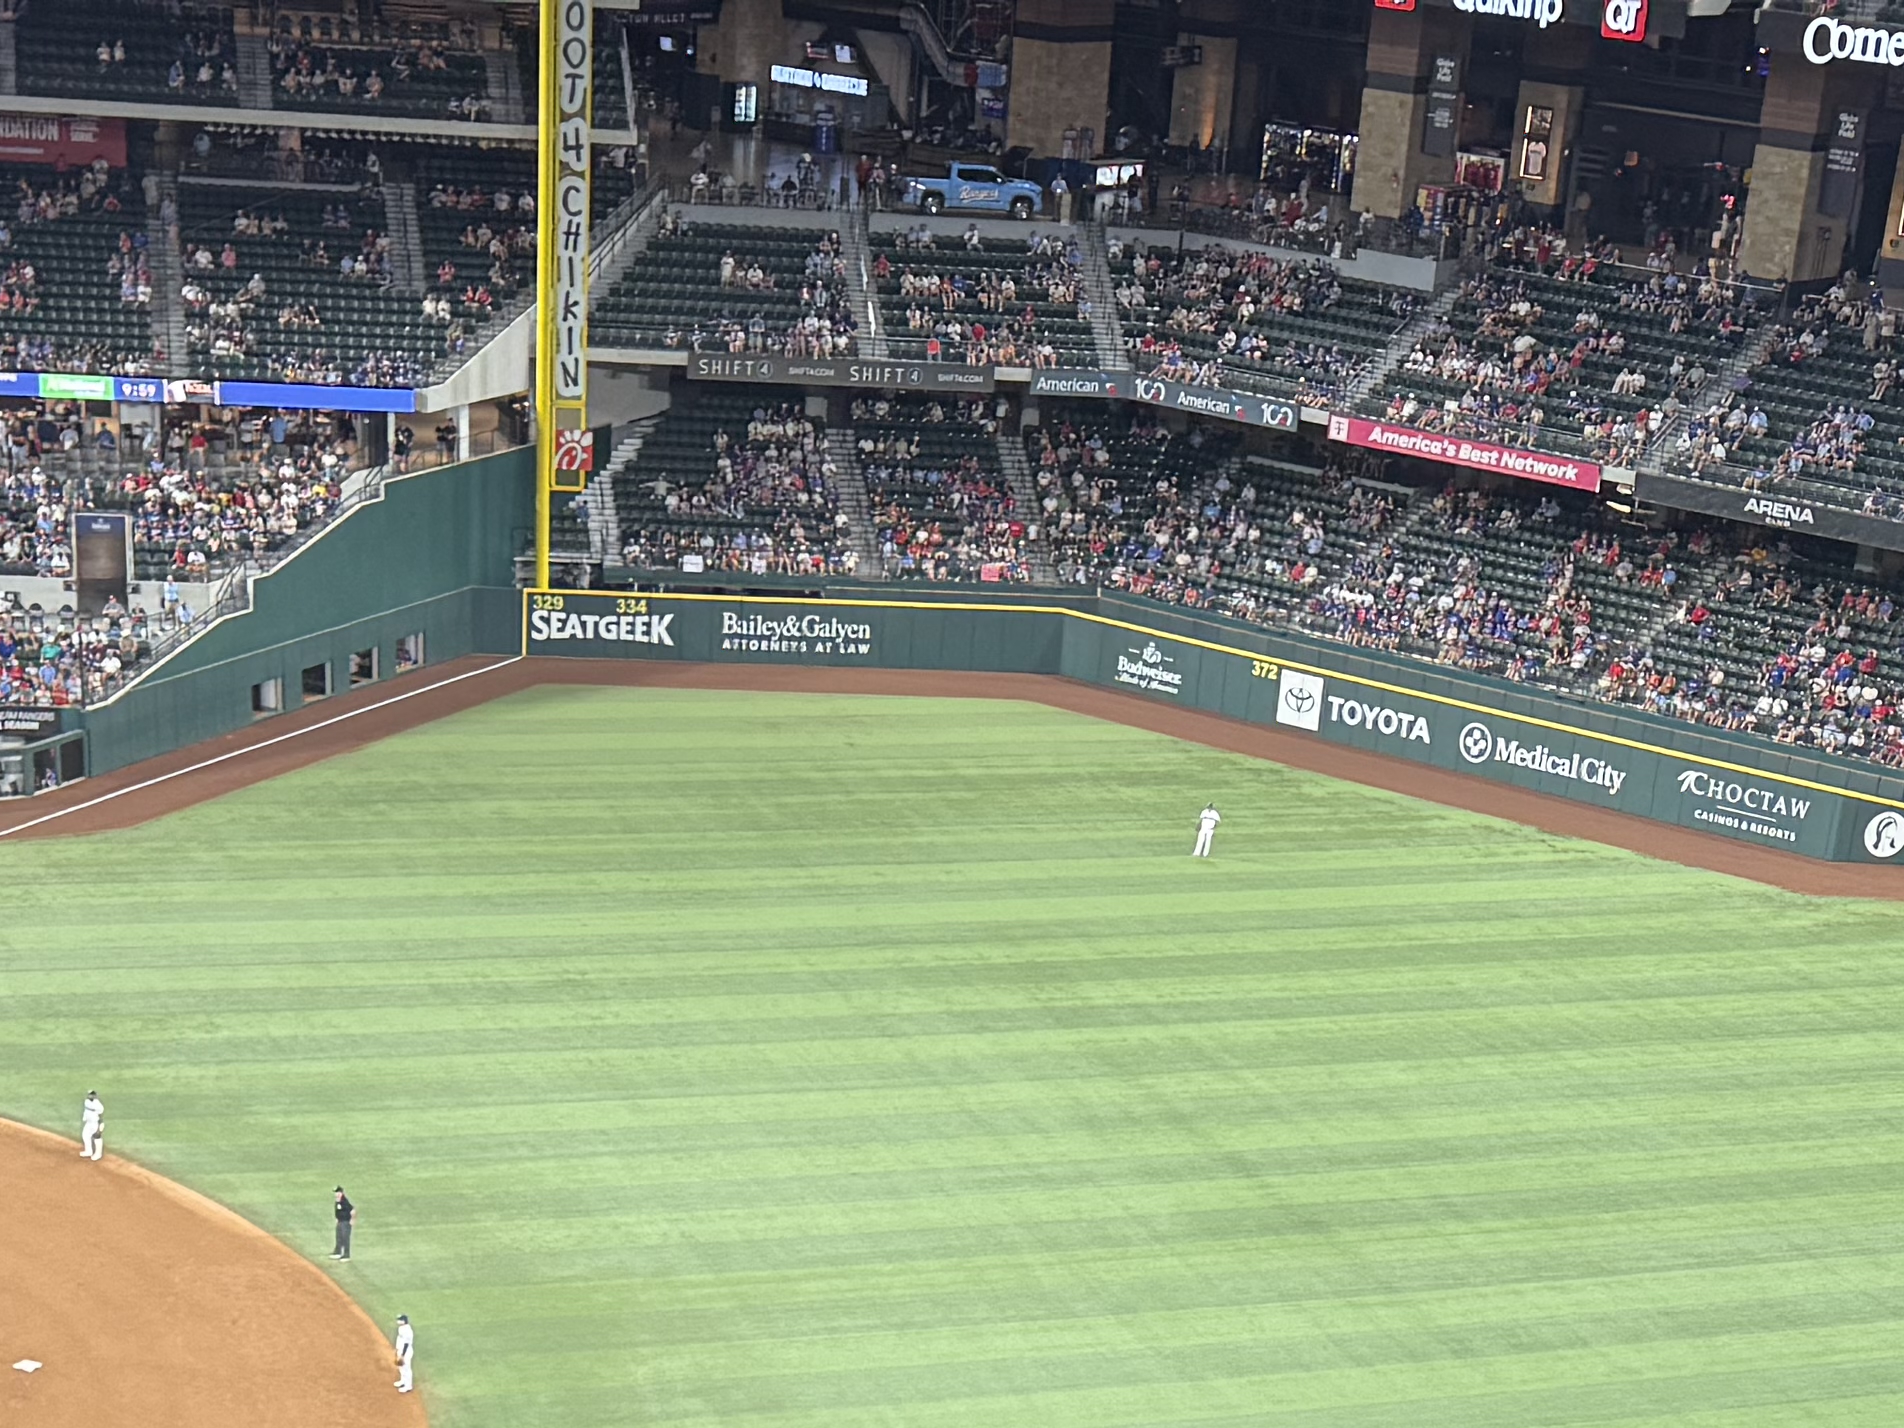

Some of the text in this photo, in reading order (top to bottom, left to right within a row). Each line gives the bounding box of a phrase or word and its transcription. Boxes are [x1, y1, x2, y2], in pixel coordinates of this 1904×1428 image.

[562, 127, 584, 161] 4
[561, 185, 582, 389] CHIKIN
[121, 383, 156, 397] 9:59
[1036, 376, 1099, 392] American
[1177, 391, 1230, 414] American
[1368, 426, 1580, 481] America's Best Network
[1744, 498, 1814, 525] ARENA
[533, 595, 564, 611] 329
[616, 598, 648, 614] 334
[531, 610, 675, 647] SEATGEEK
[722, 638, 871, 654] ATTORNEYS AT LAW
[1118, 656, 1182, 685] Budweiser
[1251, 661, 1278, 680] 372
[1327, 696, 1431, 744] TOYOTA
[1495, 742, 1627, 796] Medical City
[1687, 771, 1811, 820] CHOCTAW
[1694, 809, 1739, 830] CASINOS
[1749, 822, 1796, 842] RESORTS
